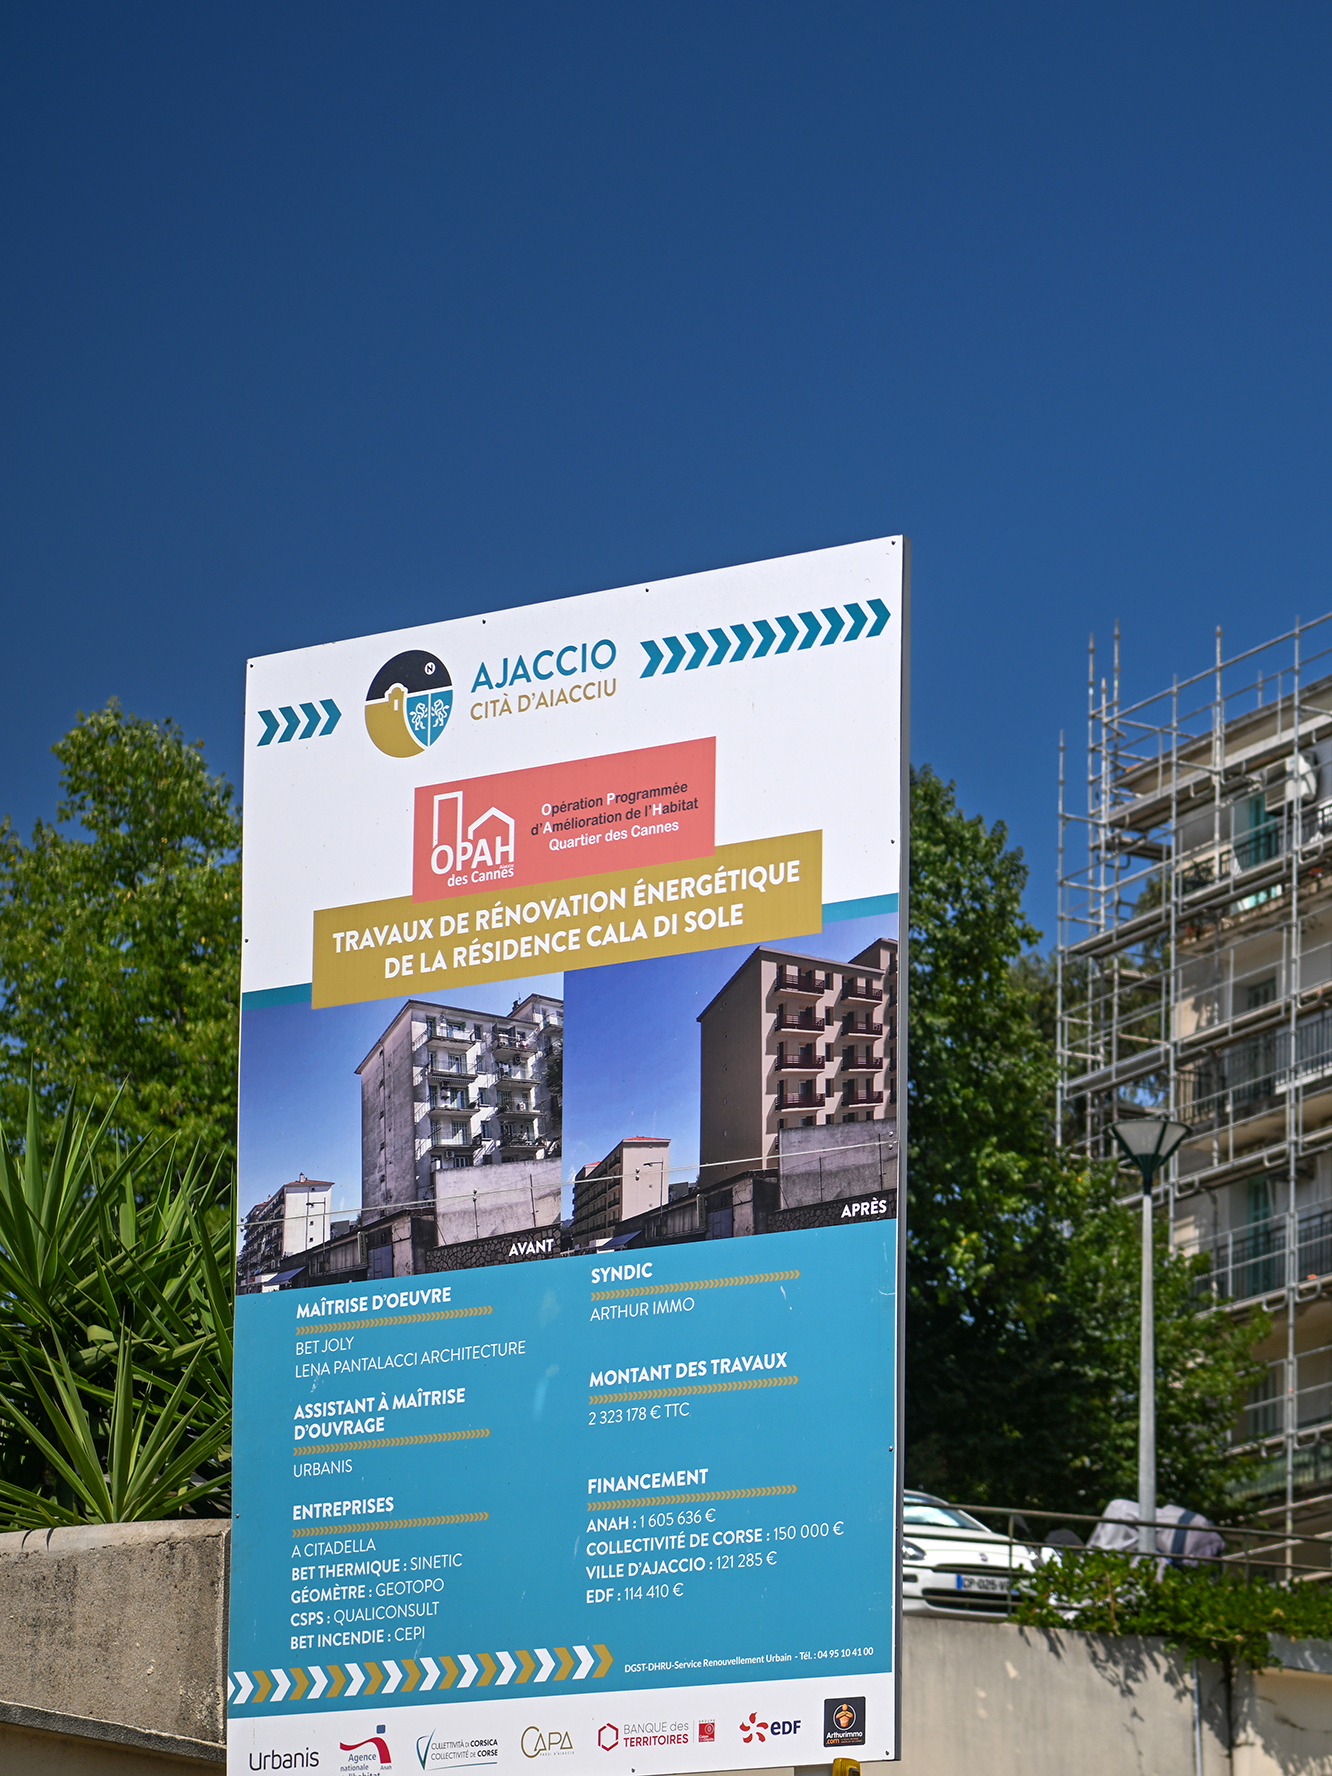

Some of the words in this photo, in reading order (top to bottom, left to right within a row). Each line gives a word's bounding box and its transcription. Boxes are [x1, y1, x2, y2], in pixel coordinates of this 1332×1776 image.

[470, 638, 616, 693] AJACCIO
[470, 692, 512, 720] CITÀ
[518, 677, 616, 712] D'AIACCIU
[541, 797, 602, 817] Opération
[606, 781, 687, 805] Programmée
[530, 812, 622, 835] d'Amélioration
[625, 807, 641, 820] de
[644, 797, 698, 817] l'Habitat
[549, 833, 602, 850] Quartier
[604, 828, 628, 842] des
[630, 821, 679, 837] Cannes
[430, 836, 515, 875] OPAH
[446, 872, 468, 887] des
[471, 866, 514, 883] Cannes
[332, 917, 433, 954] TRAVAUX
[440, 912, 469, 936] DE
[475, 887, 625, 931] RÉNOVATION
[633, 859, 800, 906] ÉNERGÉTIQUE
[385, 954, 414, 978] DE
[420, 950, 447, 973] LA
[453, 928, 580, 968] RÉSIDENCE
[586, 918, 648, 947] CALA
[654, 913, 677, 937] DI
[684, 903, 743, 932] SOLE
[841, 1196, 887, 1218] APRÈS
[508, 1238, 554, 1257] AVANT
[591, 1262, 652, 1283] SYNDIC
[296, 1296, 368, 1318] MAÎTRISE
[372, 1286, 451, 1310] D'OEUVRE
[589, 1302, 648, 1321] ARTHUR
[652, 1297, 694, 1314] IMMO
[295, 1339, 319, 1355] BET
[321, 1336, 354, 1352] JOLY
[295, 1362, 330, 1378] LENA
[333, 1352, 417, 1373] PANTALACCI
[420, 1340, 526, 1364] ARCHITECTURE
[589, 1364, 671, 1387] MONTANT
[675, 1360, 707, 1378] DES
[710, 1351, 787, 1374] TRAVAUX
[293, 1396, 375, 1419] ASSISTANT
[377, 1392, 389, 1411] À
[392, 1387, 465, 1409] MAÎTRISE
[588, 1411, 596, 1425] 2
[599, 1408, 622, 1424] 323
[626, 1406, 646, 1421] 178
[650, 1404, 661, 1419] €
[664, 1401, 689, 1417] TTC
[294, 1416, 384, 1440] D'OUVRAGE
[293, 1458, 352, 1477] URBANIS
[588, 1468, 708, 1494] FINANCEMENT
[293, 1496, 393, 1520] ENTREPRISES
[586, 1515, 628, 1533] ANAH
[639, 1515, 644, 1528] 1
[648, 1512, 673, 1527] 605
[677, 1509, 701, 1525] 636
[705, 1507, 716, 1522] €
[291, 1544, 301, 1558] A
[303, 1538, 376, 1557] CITADELLA
[586, 1531, 685, 1556] COLLECTIVITÉ
[689, 1532, 709, 1547] DE
[712, 1528, 762, 1545] CORSE
[773, 1525, 796, 1540] 150
[800, 1522, 829, 1538] 000
[832, 1520, 844, 1535] €
[291, 1565, 315, 1581] BET
[317, 1558, 400, 1578] THERMIQUE
[410, 1552, 462, 1570] SINETIC
[585, 1563, 624, 1579] VILLE
[628, 1556, 705, 1576] D'AJACCIO
[716, 1554, 733, 1569] 121
[737, 1552, 762, 1567] 285
[766, 1550, 777, 1565] €
[291, 1583, 365, 1603] GÉOMÈTRE
[375, 1577, 444, 1596] GEOTOPO
[586, 1587, 614, 1603] EDF
[624, 1586, 643, 1600] 114
[645, 1583, 669, 1598] 410
[672, 1582, 683, 1596] €
[290, 1610, 323, 1626] CSPS
[333, 1601, 439, 1625] QUALICONSULT
[290, 1634, 314, 1649] BET
[317, 1629, 384, 1647] INCENDIE
[394, 1625, 424, 1641] CEPI
[624, 1659, 702, 1673] DGST-DHRU-Service
[703, 1655, 764, 1667] Renouvellement
[765, 1652, 791, 1662] Urbain
[817, 1650, 828, 1659] 04
[828, 1649, 839, 1658] 95
[840, 1648, 851, 1657] 10
[851, 1647, 862, 1656] 41
[862, 1646, 873, 1656] 00
[623, 1721, 668, 1736] BANQUE
[669, 1721, 689, 1733] des
[623, 1733, 689, 1748] TERRITOIRES
[826, 1730, 863, 1739] Arthurimmo
[431, 1750, 469, 1760] COLLECTIVITÉ
[477, 1749, 498, 1757] CORSE
[470, 1739, 498, 1747] CORSICA
[521, 1726, 574, 1758] CAPA
[249, 1746, 319, 1771] Urbanis
[340, 1764, 369, 1772] nationale
[348, 1753, 377, 1764] Agence
